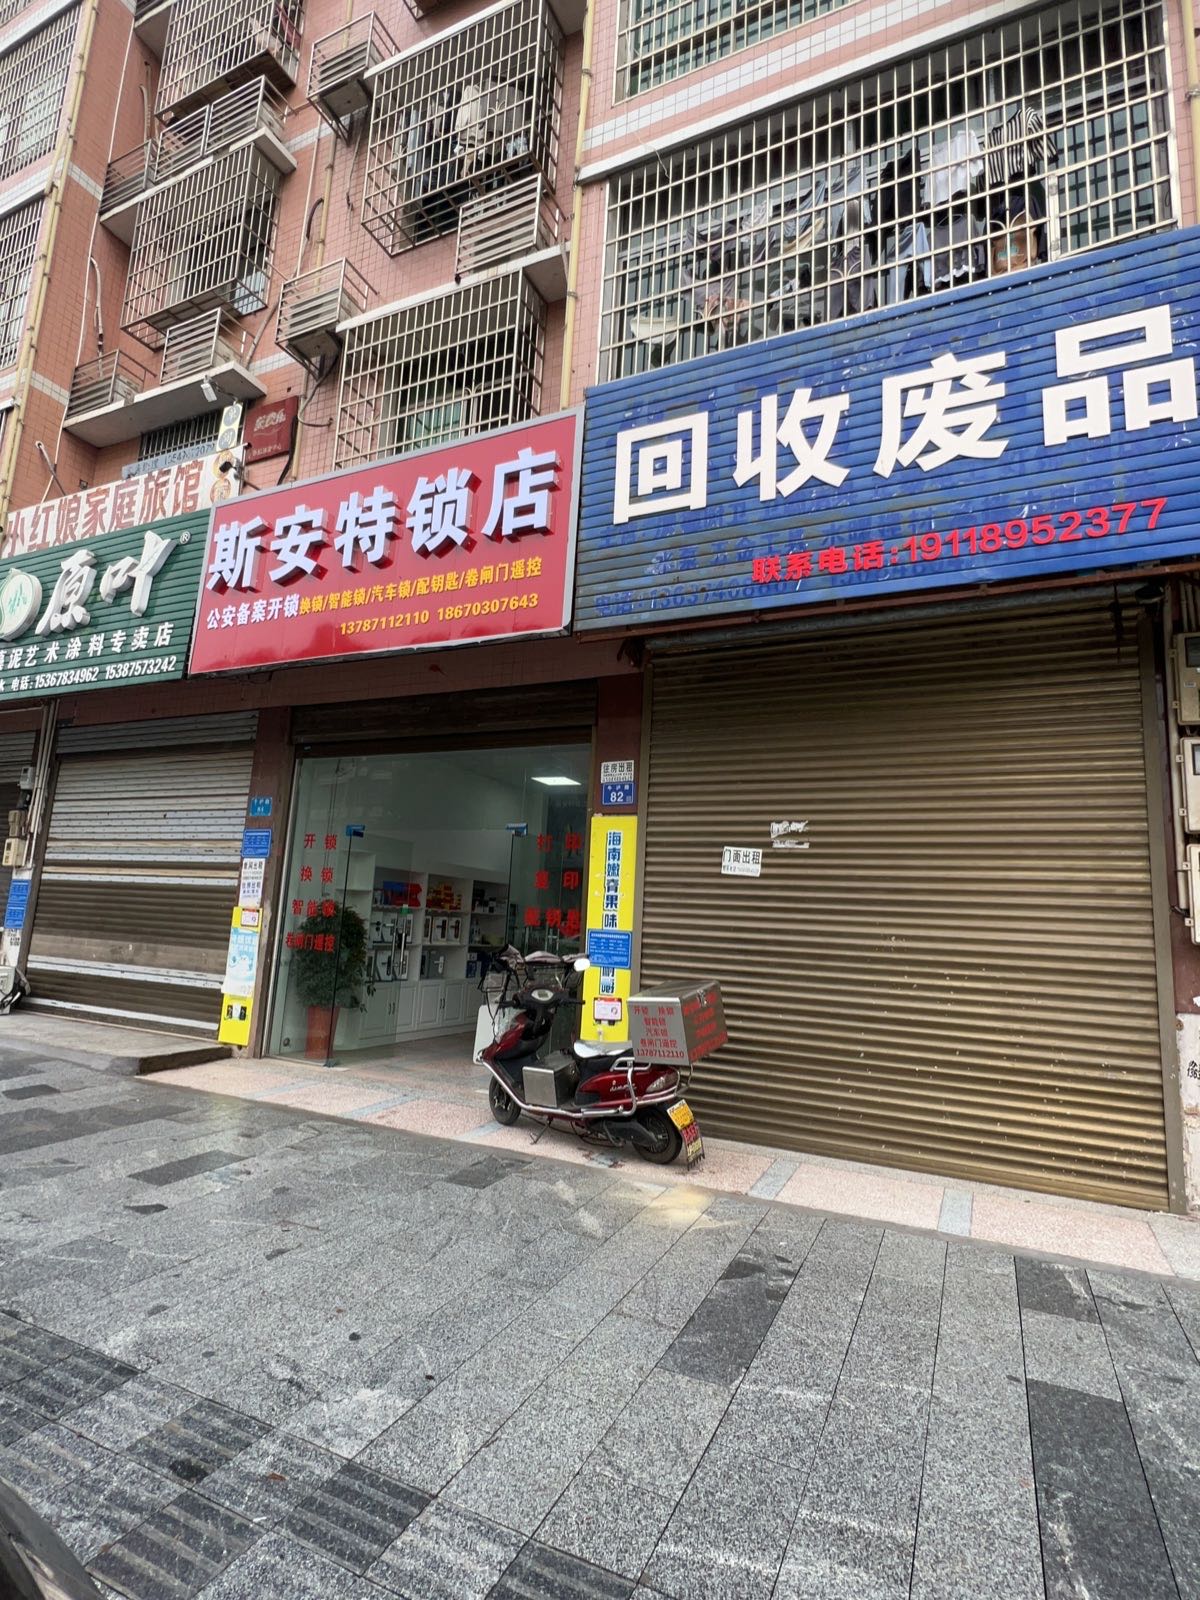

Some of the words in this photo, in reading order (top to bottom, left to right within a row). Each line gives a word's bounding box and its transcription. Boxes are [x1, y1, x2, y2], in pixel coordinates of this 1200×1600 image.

[612, 303, 1199, 525] 回收废品
[207, 448, 560, 592] 斯安特锁店
[340, 609, 430, 636] 13787112110
[437, 592, 539, 623] 18670307643
[105, 655, 177, 680] 15387573242
[610, 791, 624, 803] 82
